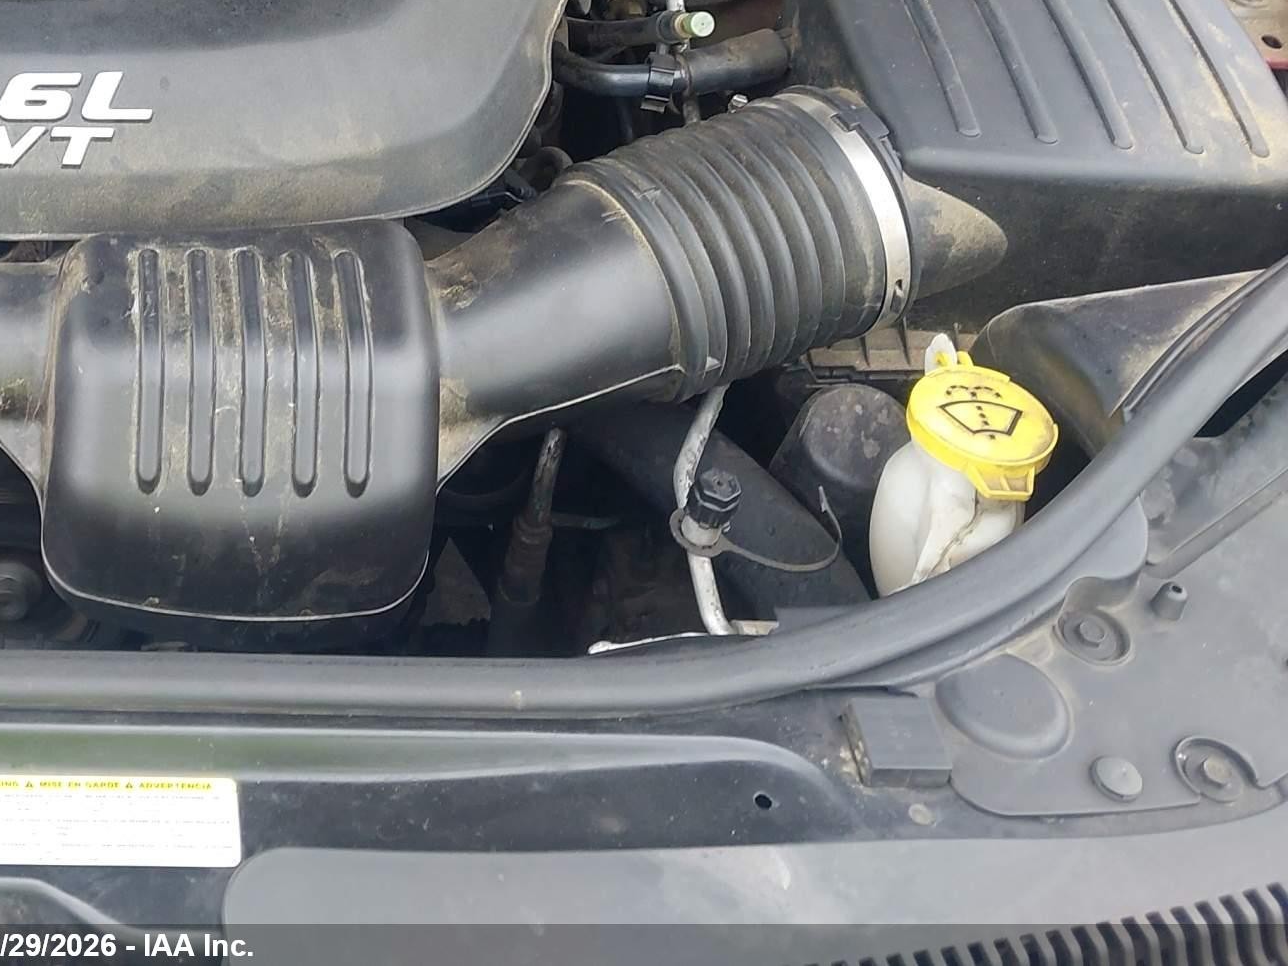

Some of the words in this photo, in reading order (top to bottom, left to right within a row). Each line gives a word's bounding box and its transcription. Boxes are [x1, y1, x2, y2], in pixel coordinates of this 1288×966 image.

[39, 780, 63, 788] MISE
[67, 780, 82, 788] EN
[85, 781, 120, 789] GARDE
[138, 781, 213, 790] ADVERTENCIA
